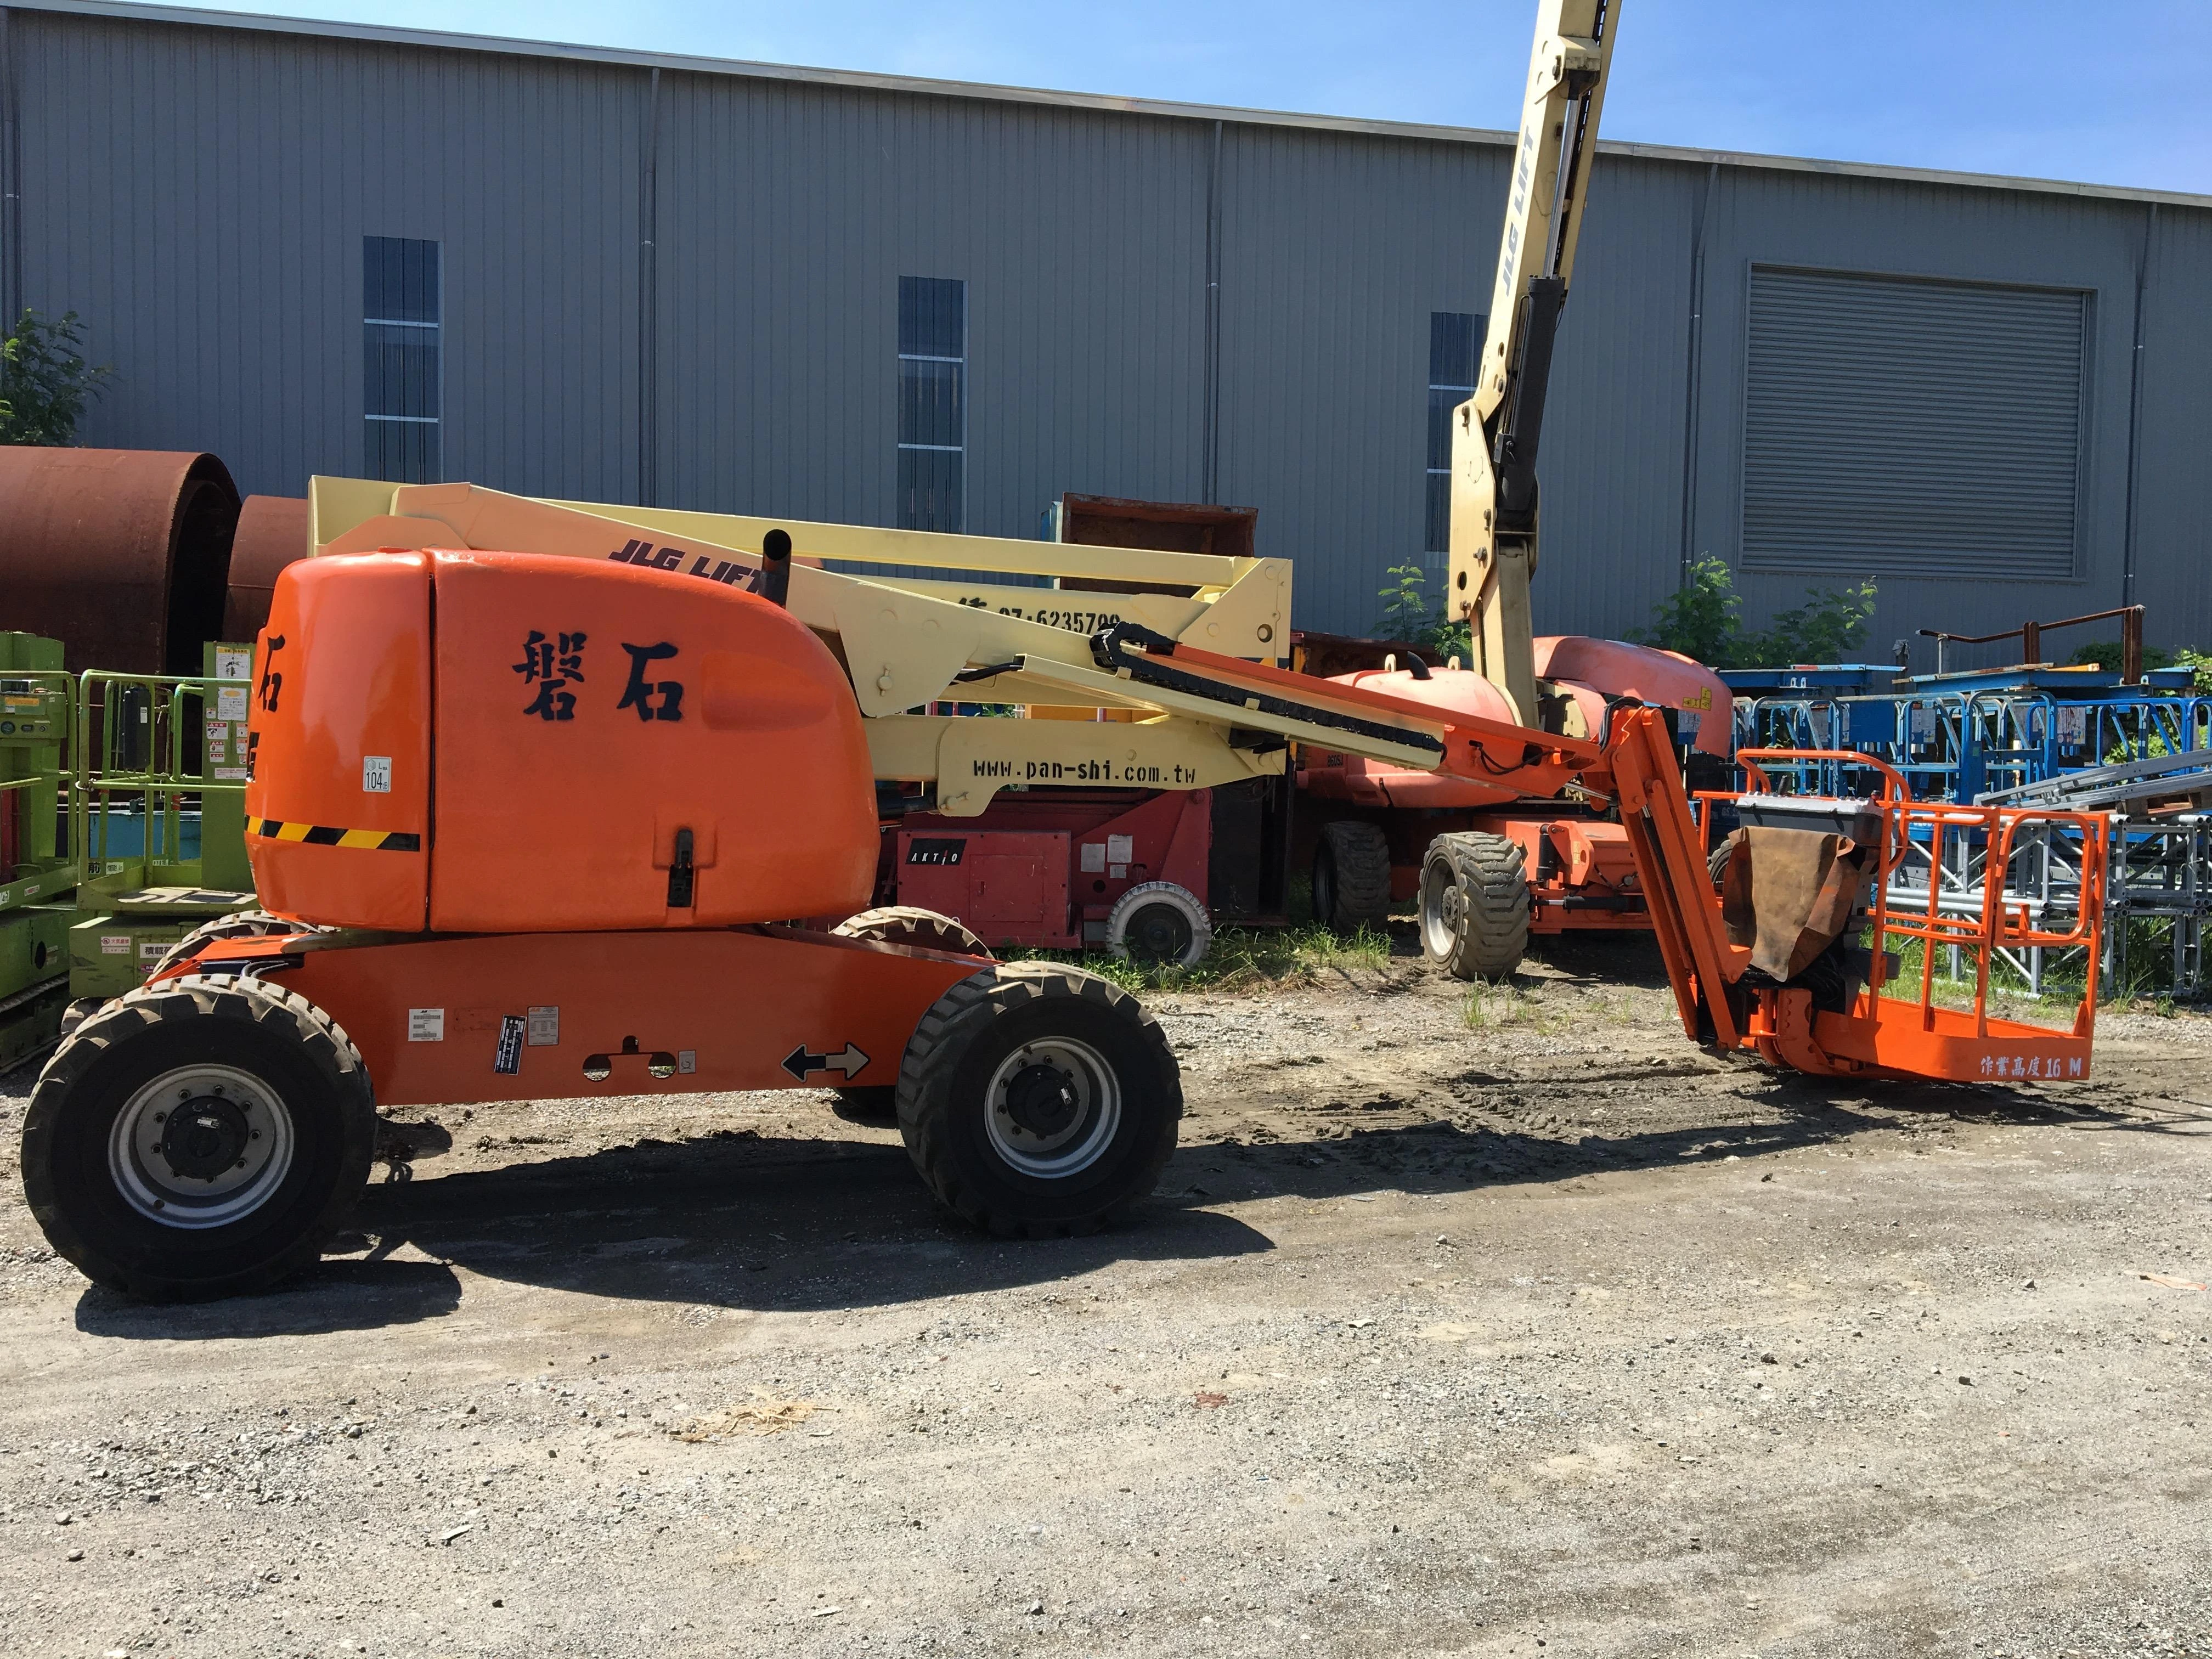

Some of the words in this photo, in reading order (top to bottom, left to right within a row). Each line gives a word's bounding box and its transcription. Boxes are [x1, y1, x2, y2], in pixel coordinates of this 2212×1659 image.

[1503, 222, 1518, 297] JLG
[1513, 125, 1533, 216] LIFT
[608, 539, 686, 571] JLG
[366, 771, 382, 789] 104
[973, 759, 1197, 786] www.pan-shi.com.tw
[911, 850, 957, 865] AKTIO
[1980, 1056, 2040, 1077] 作業高度
[2045, 1058, 2061, 1078] 16
[2069, 1057, 2082, 1077] M
